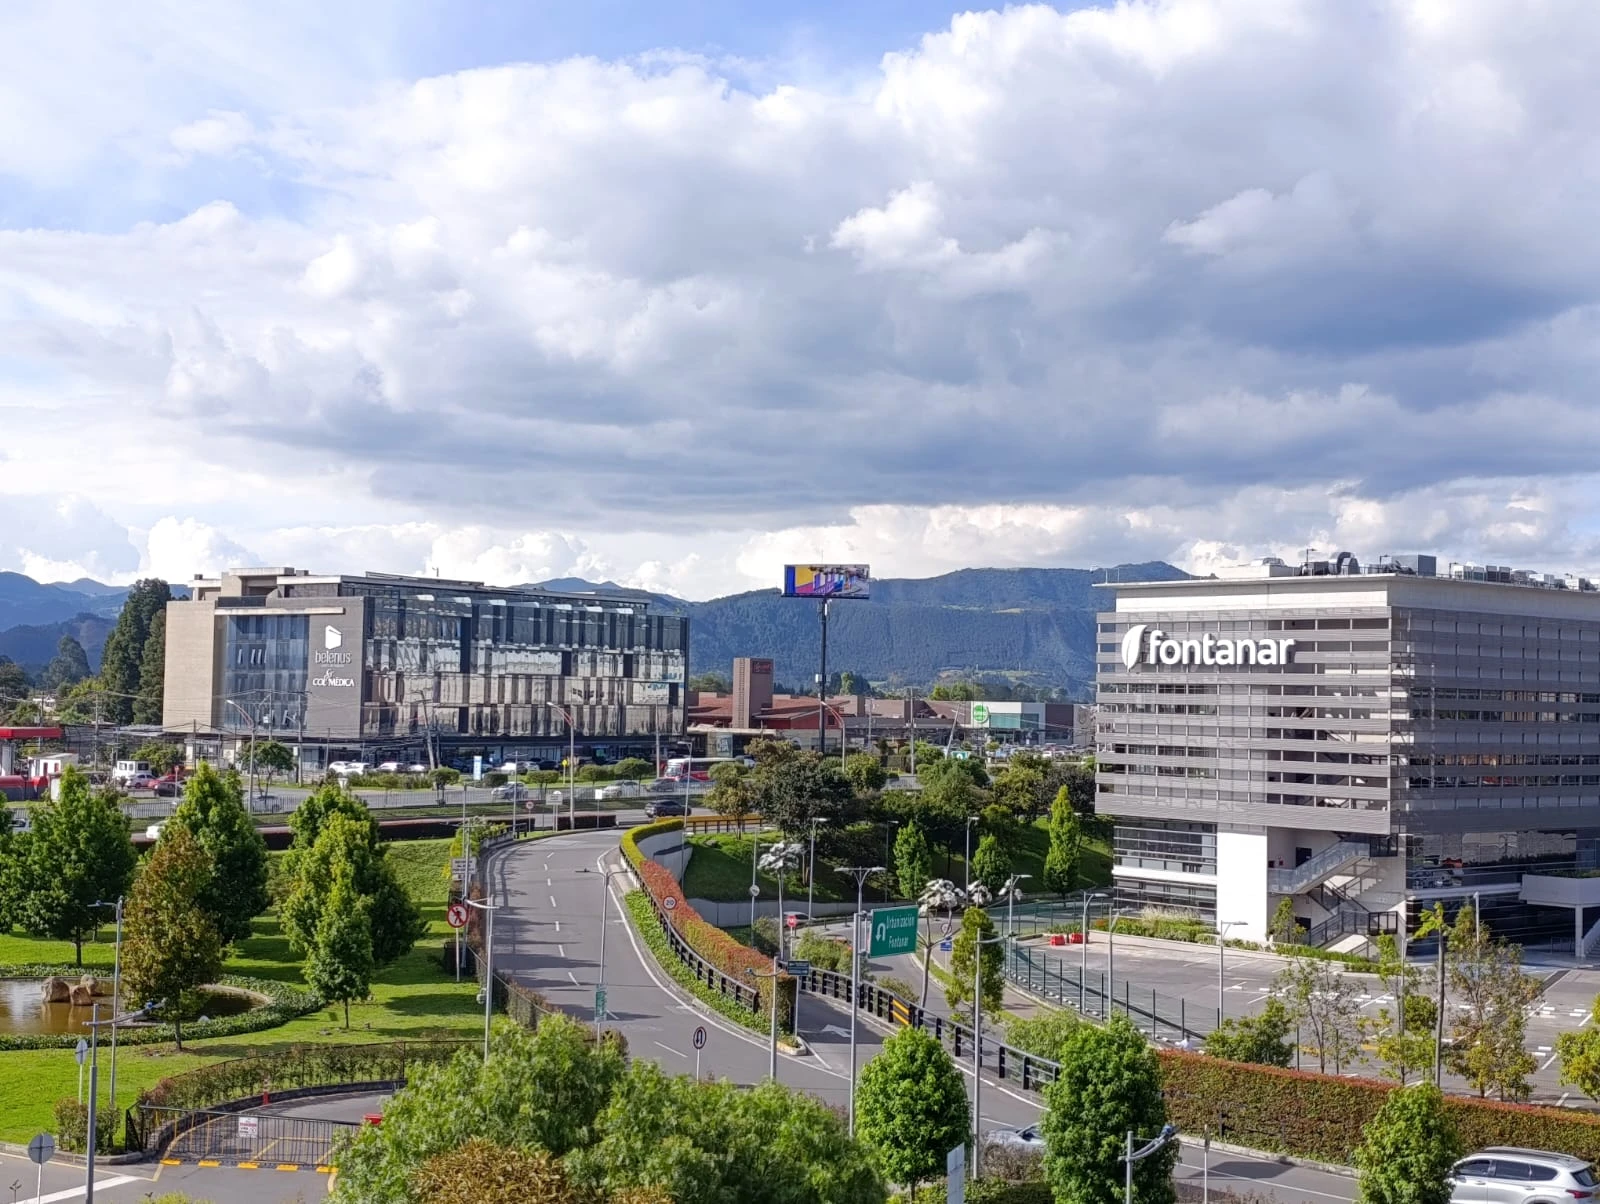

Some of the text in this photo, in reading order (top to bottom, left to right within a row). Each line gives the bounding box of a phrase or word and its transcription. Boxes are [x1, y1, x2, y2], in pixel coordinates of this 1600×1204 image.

[1150, 630, 1295, 665] fontanar
[315, 650, 351, 664] belenus
[886, 914, 915, 929] Urbanización
[889, 935, 909, 949] Fontanar
